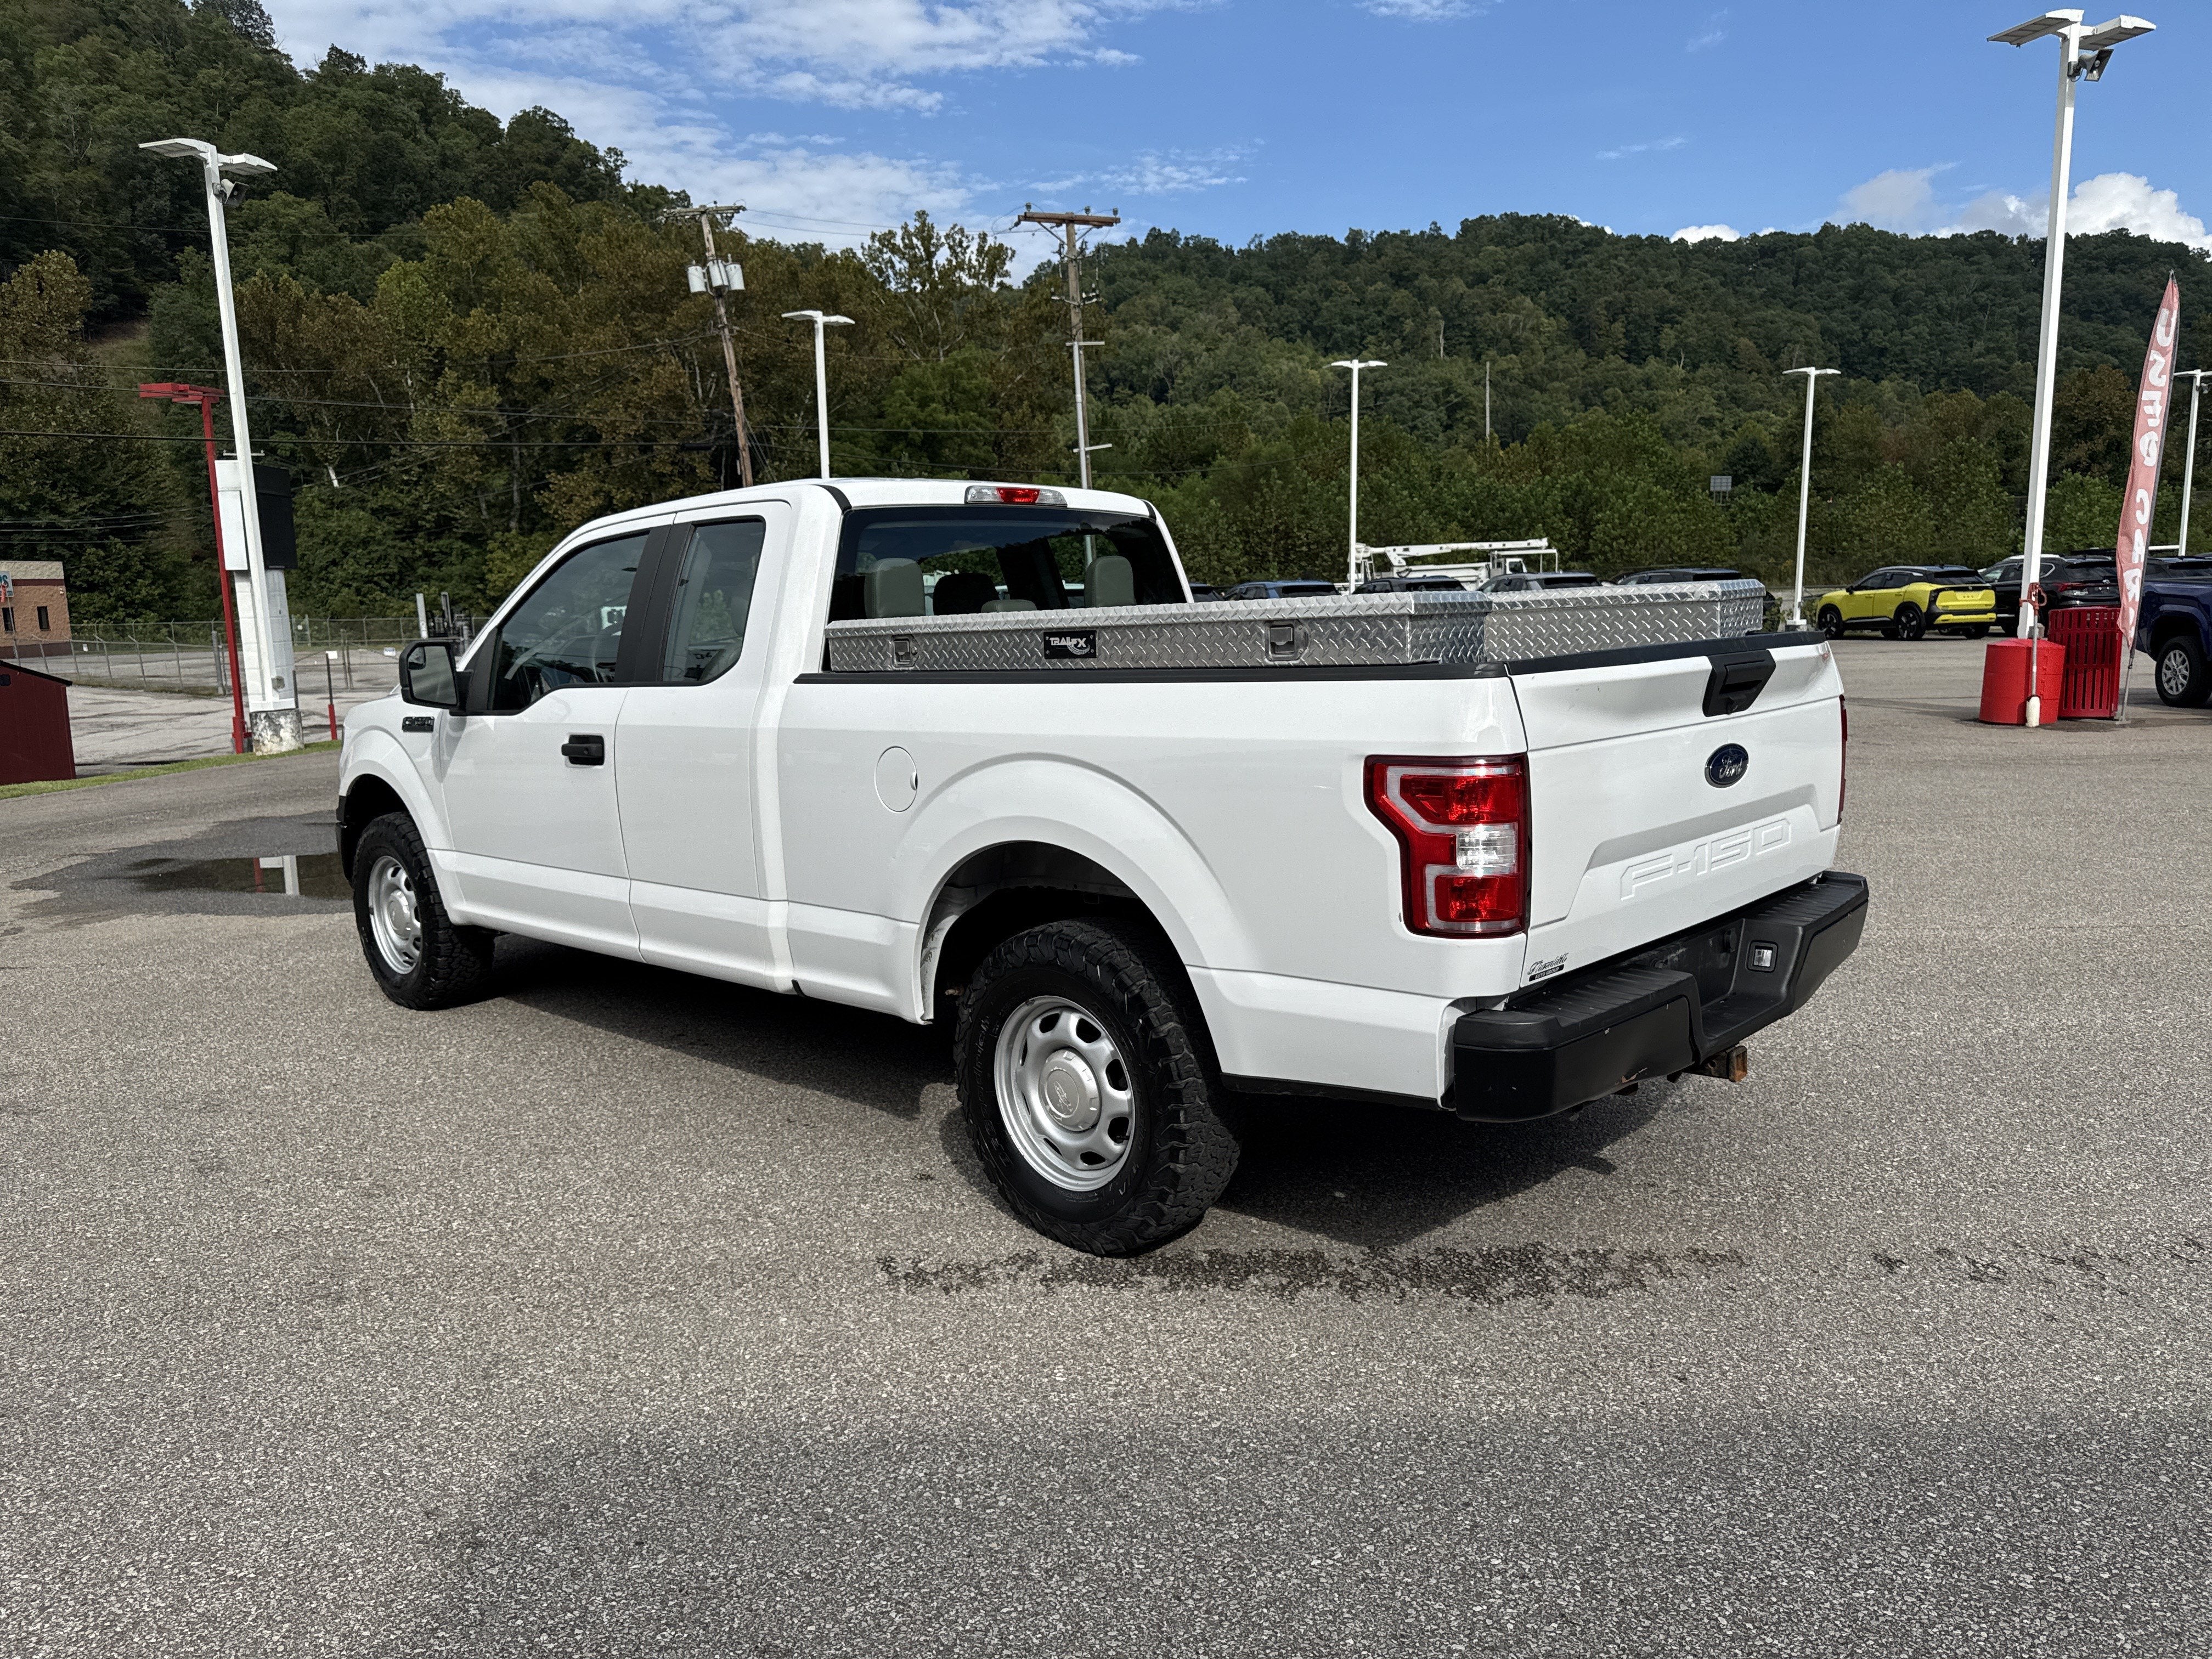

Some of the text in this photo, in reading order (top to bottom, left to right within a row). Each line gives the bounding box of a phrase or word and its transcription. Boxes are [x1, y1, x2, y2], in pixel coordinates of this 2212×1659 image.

[1719, 754, 1742, 778] Ford
[1620, 818, 1791, 900] F-150
[1545, 967, 1559, 975] GROUP
